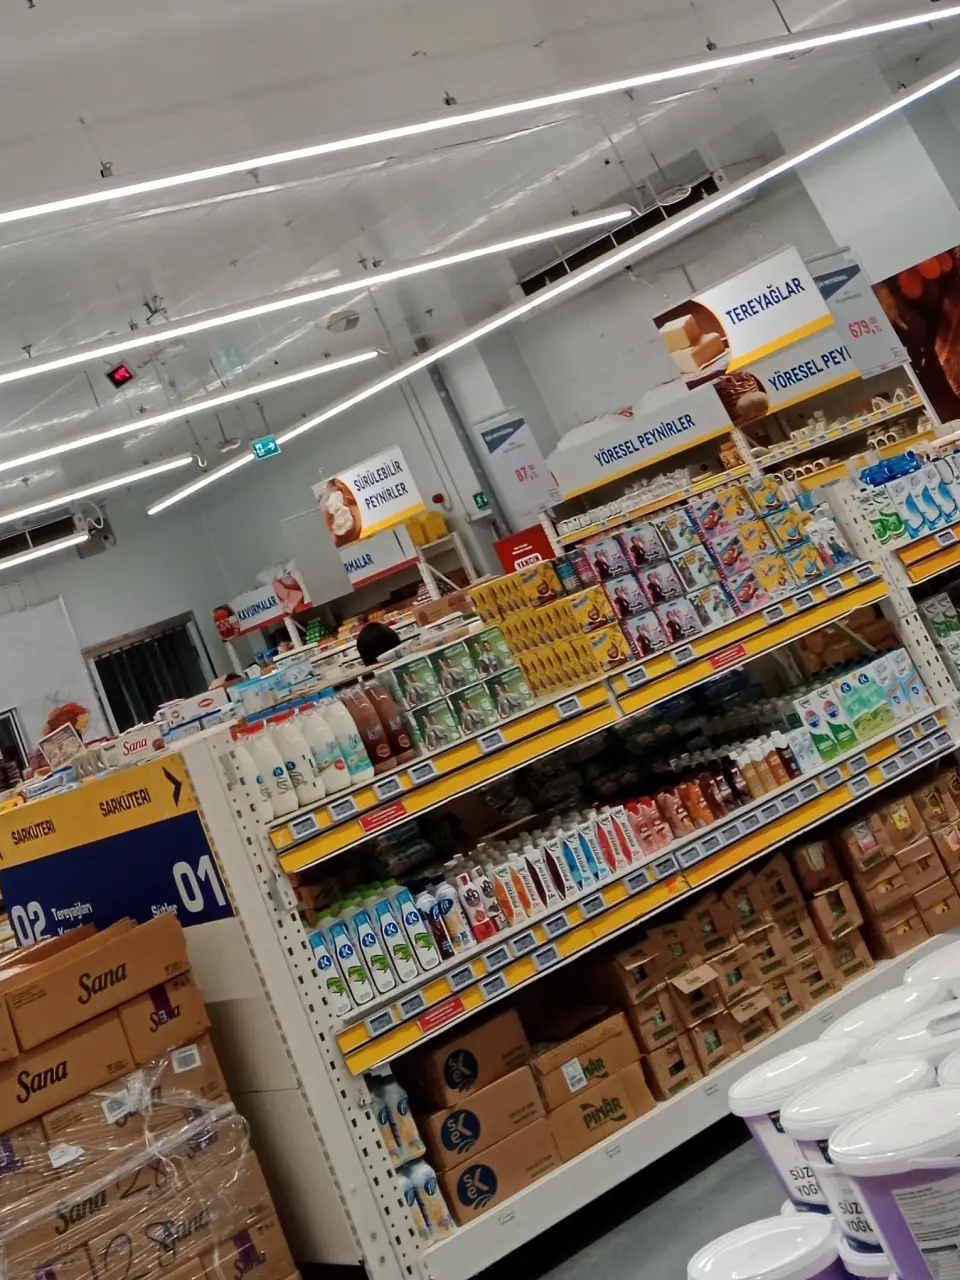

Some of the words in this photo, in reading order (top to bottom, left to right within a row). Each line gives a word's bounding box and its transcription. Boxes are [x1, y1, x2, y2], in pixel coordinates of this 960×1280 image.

[725, 277, 806, 325] TEREYAĞLAR
[768, 357, 824, 391] YÖRESEL
[594, 438, 641, 467] YÖRESEL
[637, 413, 696, 450] PEYNİRLER
[353, 459, 404, 492] SÜRÜLEBİLİR
[364, 481, 409, 510] PEYNİRLER
[123, 738, 147, 757] Sana
[99, 787, 153, 817] SARKÜTERİ
[11, 816, 57, 846] SARKÜTERİ
[172, 854, 227, 913] 01
[11, 901, 51, 947] 02
[78, 963, 128, 1006] Sana
[16, 1061, 68, 1104] Sana
